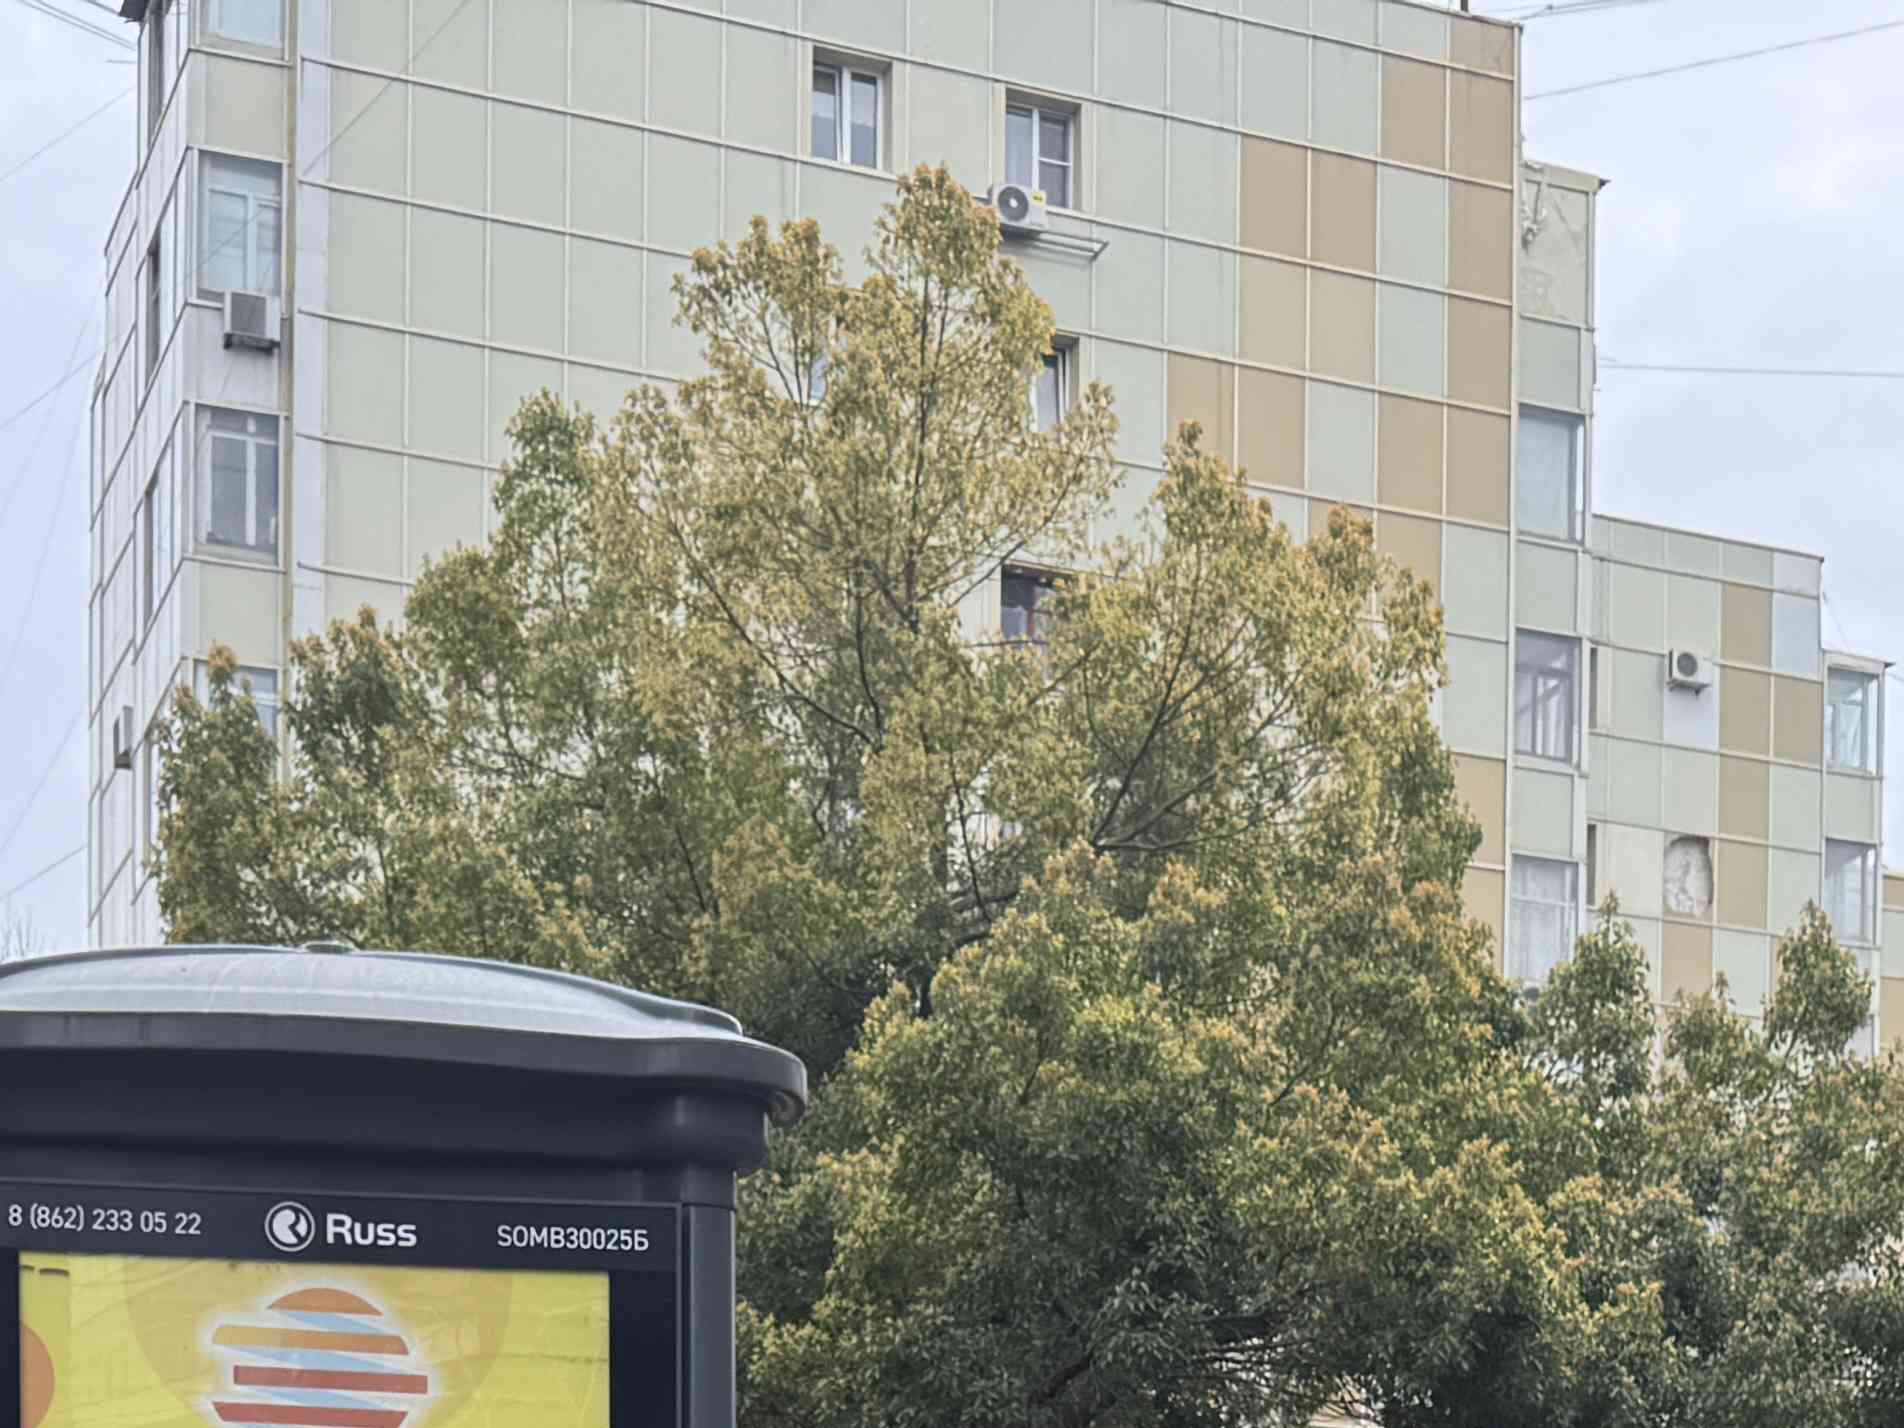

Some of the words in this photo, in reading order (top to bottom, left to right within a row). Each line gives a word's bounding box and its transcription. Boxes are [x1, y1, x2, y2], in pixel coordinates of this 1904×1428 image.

[8, 1205, 22, 1227] 8
[29, 1205, 85, 1233] (862)
[92, 1208, 135, 1231] 233
[140, 1210, 168, 1233] 05
[173, 1212, 202, 1234] 22
[326, 1212, 417, 1248] Russ
